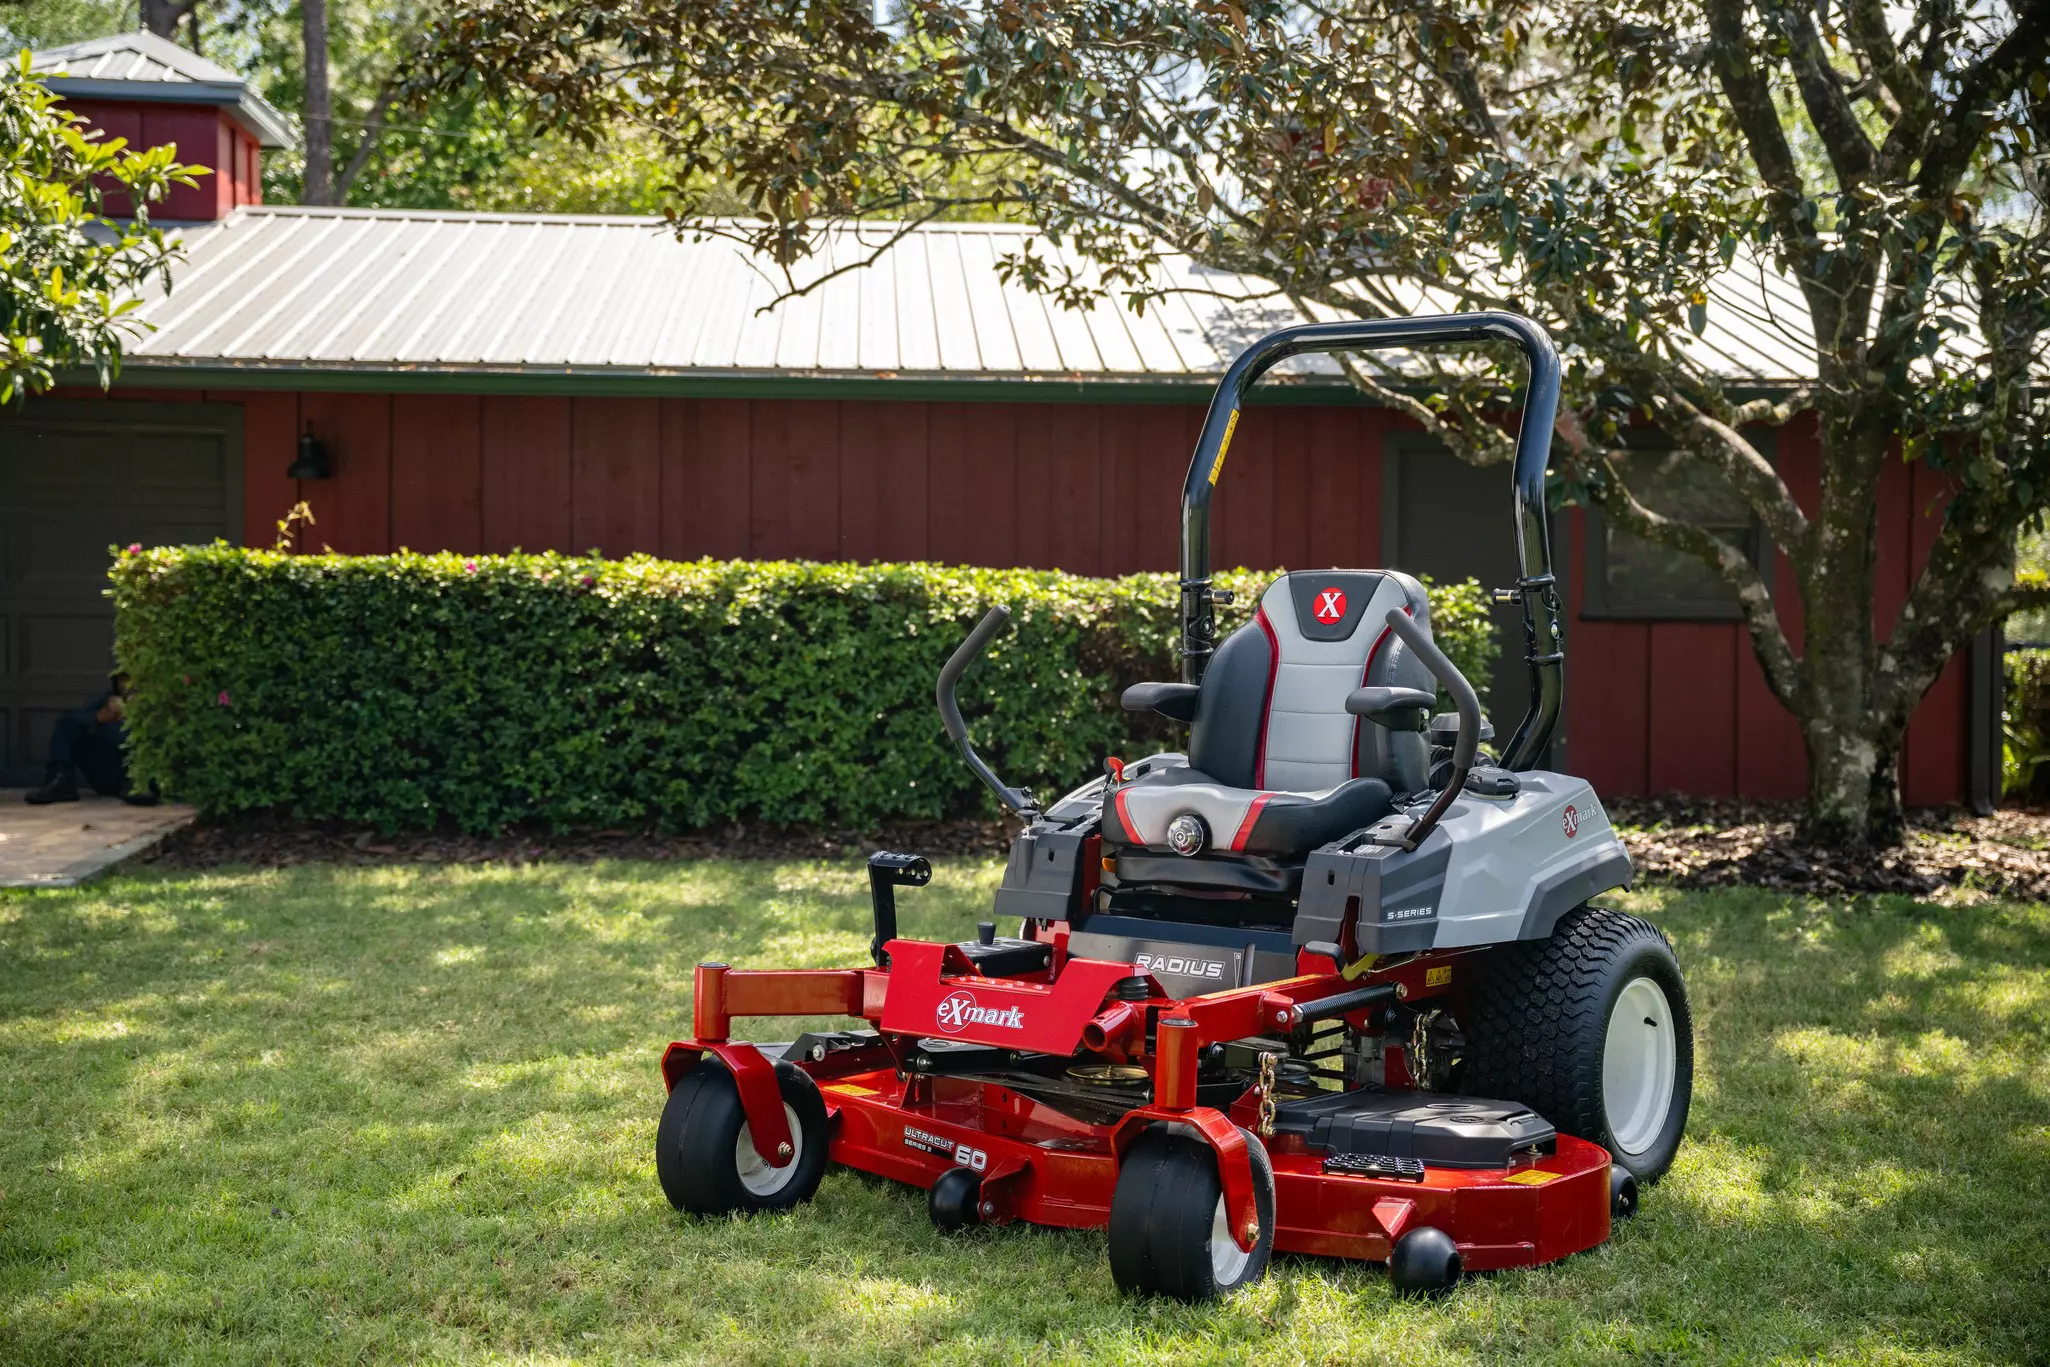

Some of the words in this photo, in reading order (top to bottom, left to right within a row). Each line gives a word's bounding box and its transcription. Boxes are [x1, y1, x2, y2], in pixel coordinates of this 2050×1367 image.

[1317, 592, 1342, 618] X
[1135, 953, 1225, 979] RADIUS
[937, 997, 1025, 1029] eXmark
[904, 1125, 955, 1151] ULTRACUT
[904, 1138, 926, 1151] SERIES
[955, 1144, 987, 1172] 60
